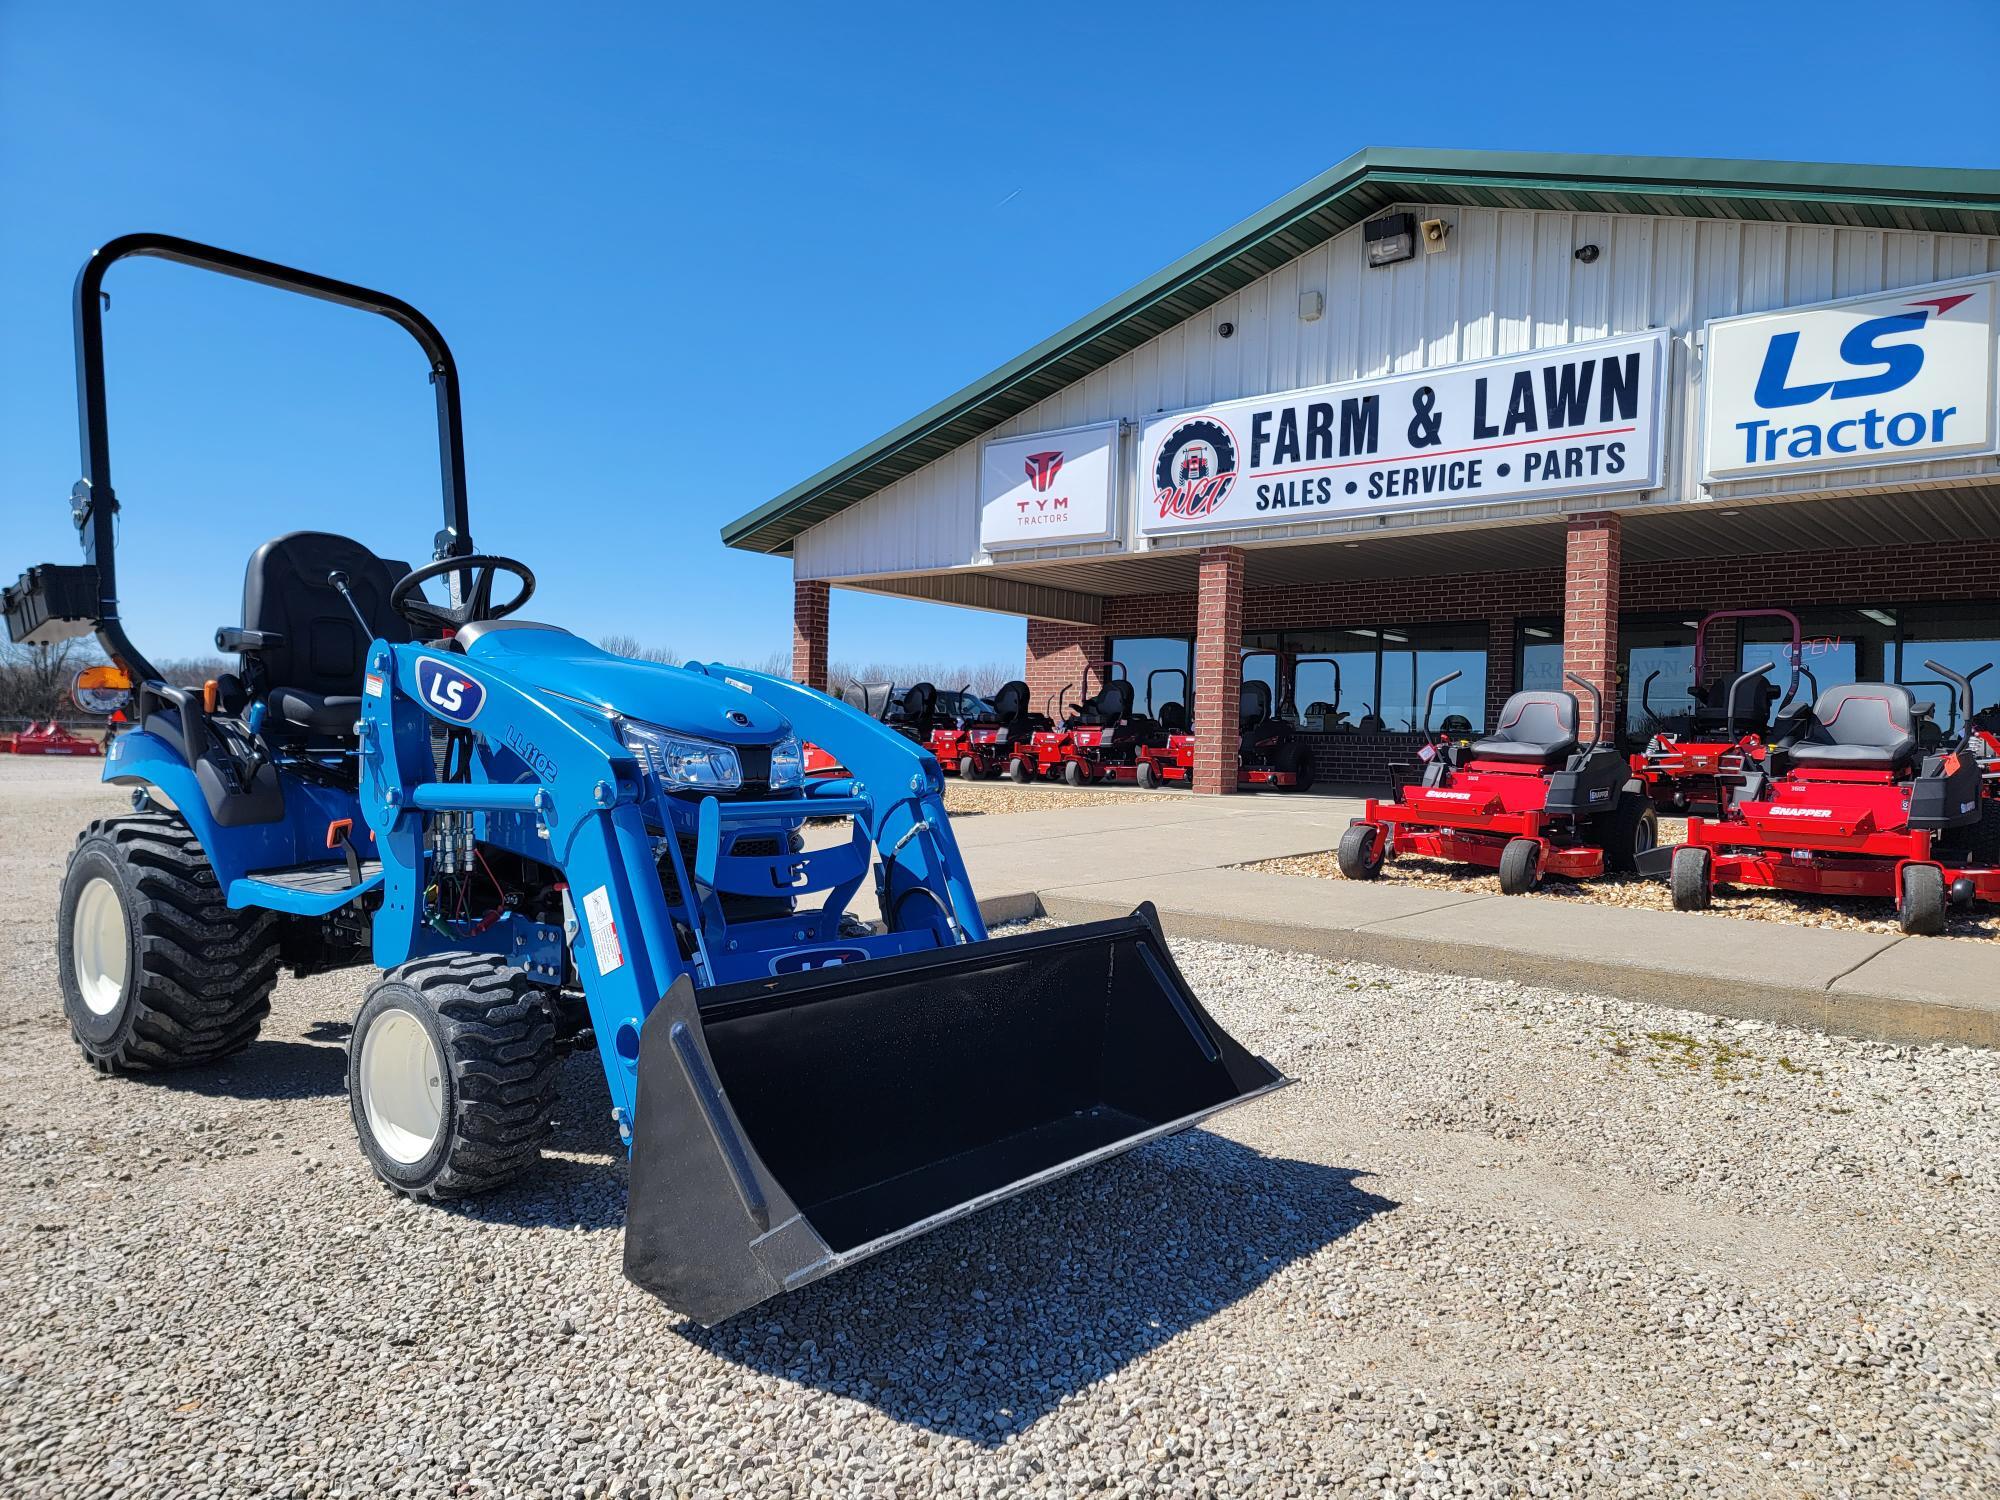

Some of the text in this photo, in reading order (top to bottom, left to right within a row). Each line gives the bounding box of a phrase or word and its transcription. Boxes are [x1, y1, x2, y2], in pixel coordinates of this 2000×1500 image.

[1754, 311, 1929, 409] LS
[1250, 353, 1641, 469] FARM & LAWN
[1735, 406, 1957, 463] Tractor
[1153, 471, 1237, 520] WCT
[1256, 442, 1627, 512] SALES SERVICE PARTS
[1017, 497, 1068, 513] TYM
[1018, 513, 1068, 526] TRACTORS
[430, 672, 465, 712] LS
[505, 725, 558, 783] LL1102
[1425, 790, 1471, 800] SNAPPER
[1769, 807, 1832, 818] SNAPPER
